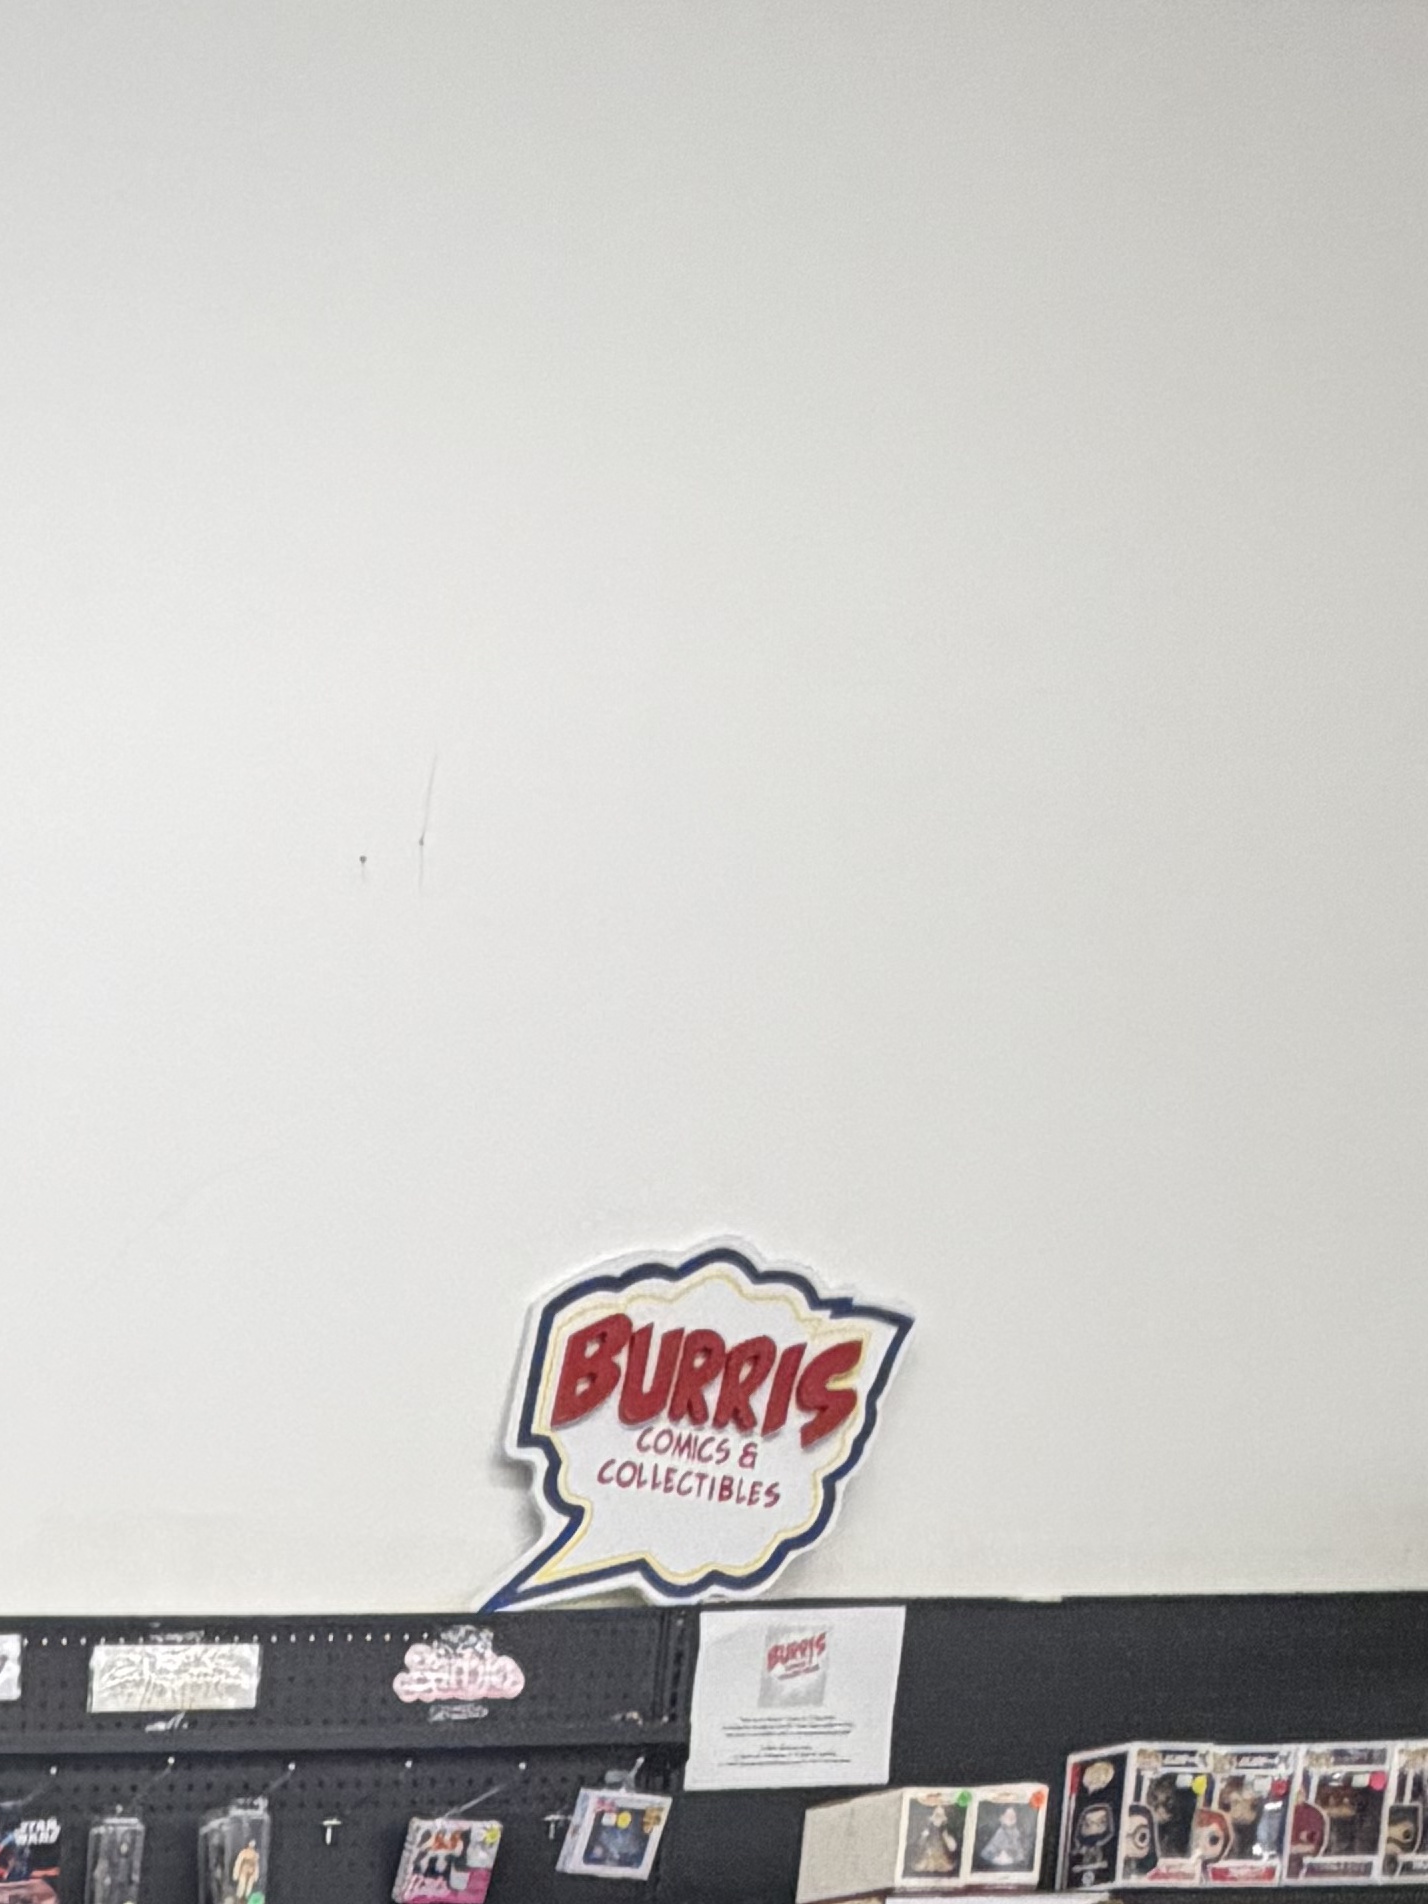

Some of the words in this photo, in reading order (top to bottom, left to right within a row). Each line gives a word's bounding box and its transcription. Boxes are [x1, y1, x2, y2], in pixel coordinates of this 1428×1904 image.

[550, 1312, 864, 1450] BURRIS
[637, 1425, 730, 1466] COMICS
[739, 1441, 758, 1469] &
[596, 1458, 780, 1508] COLLECTIBLES
[767, 1632, 826, 1672] BURRIS
